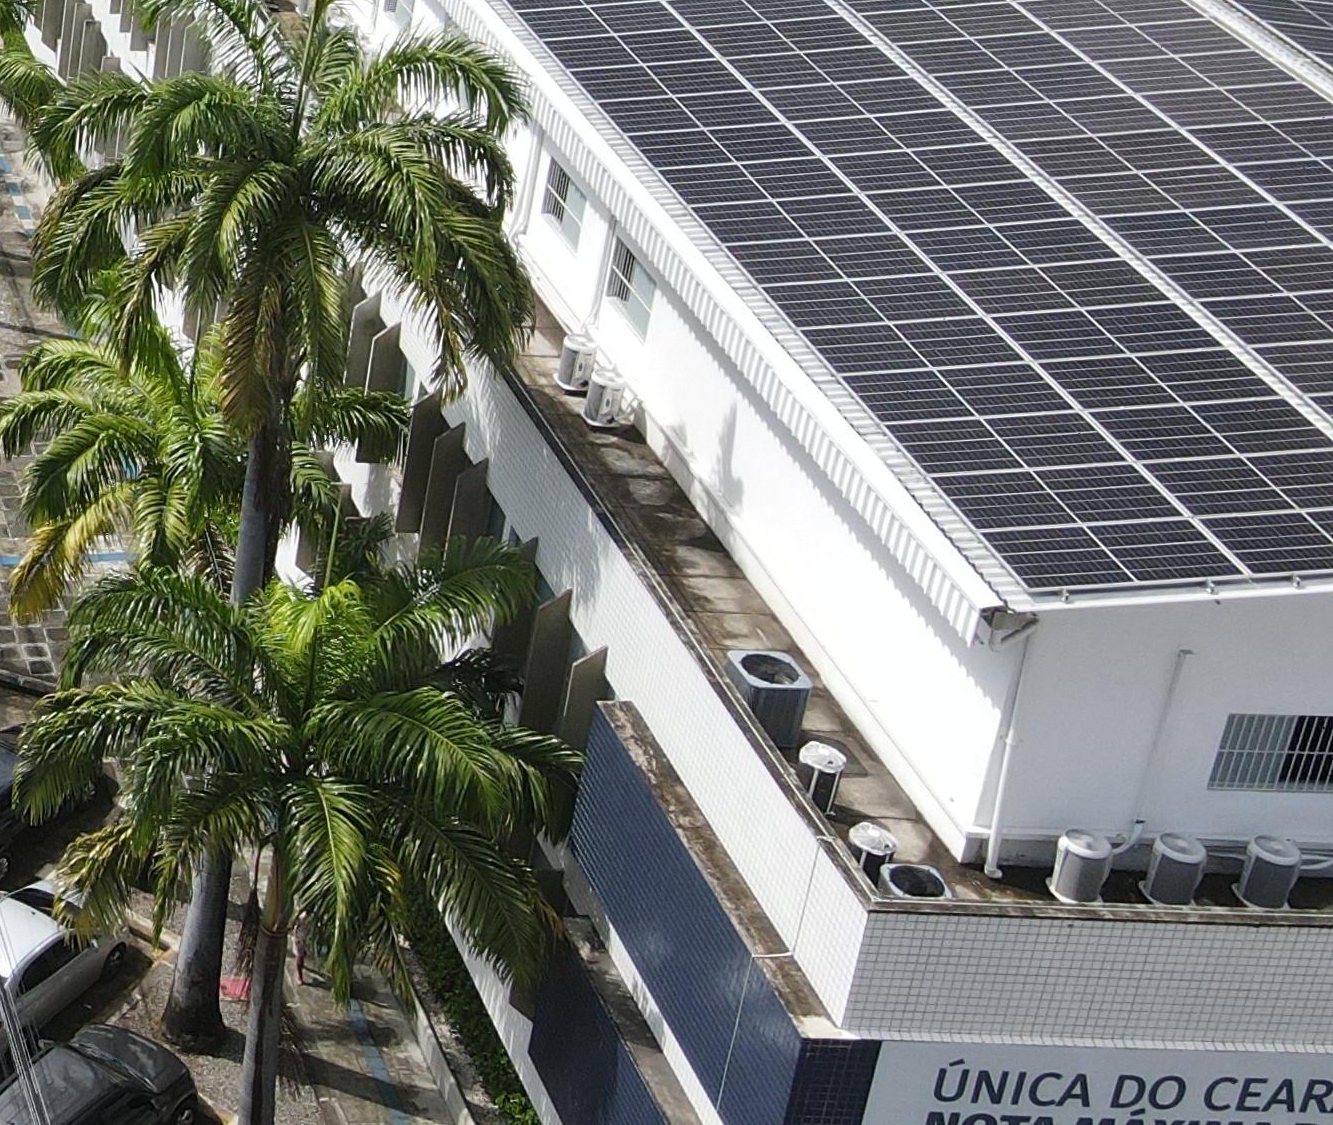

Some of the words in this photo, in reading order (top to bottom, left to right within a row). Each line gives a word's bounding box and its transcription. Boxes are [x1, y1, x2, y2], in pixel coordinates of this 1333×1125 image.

[933, 1058, 1091, 1108] ÚNICA
[1110, 1074, 1186, 1110] DO
[1204, 1077, 1333, 1114] CEAR
